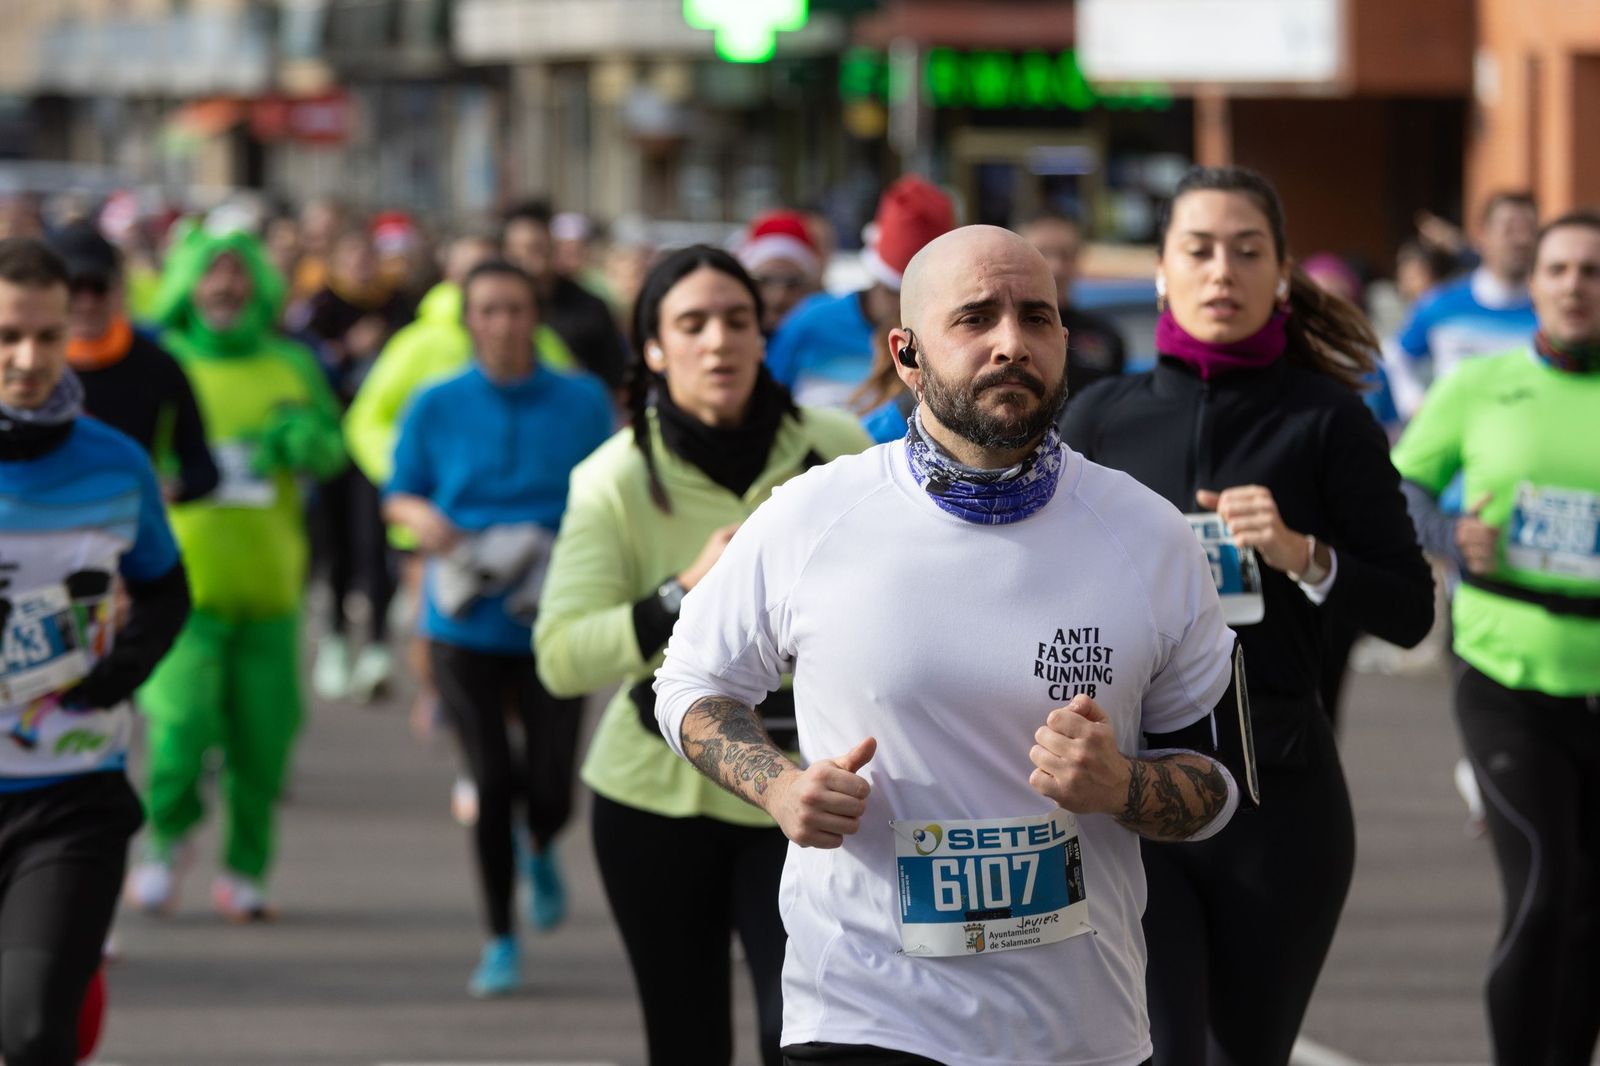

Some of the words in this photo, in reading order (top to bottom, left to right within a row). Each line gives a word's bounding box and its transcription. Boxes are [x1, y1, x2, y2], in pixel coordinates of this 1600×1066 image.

[1053, 627, 1100, 645] ANTI
[0, 619, 53, 674] 43
[1038, 642, 1113, 664] FASCIST
[1034, 660, 1113, 685] RUNNING
[1048, 683, 1097, 701] CLUB
[948, 820, 1065, 850] SETEL
[932, 853, 1040, 911] 6107
[1016, 913, 1060, 929] JAVIER
[988, 926, 1041, 940] Ayuntamiento
[990, 941, 1000, 950] de
[1001, 936, 1041, 949] Salamanca
